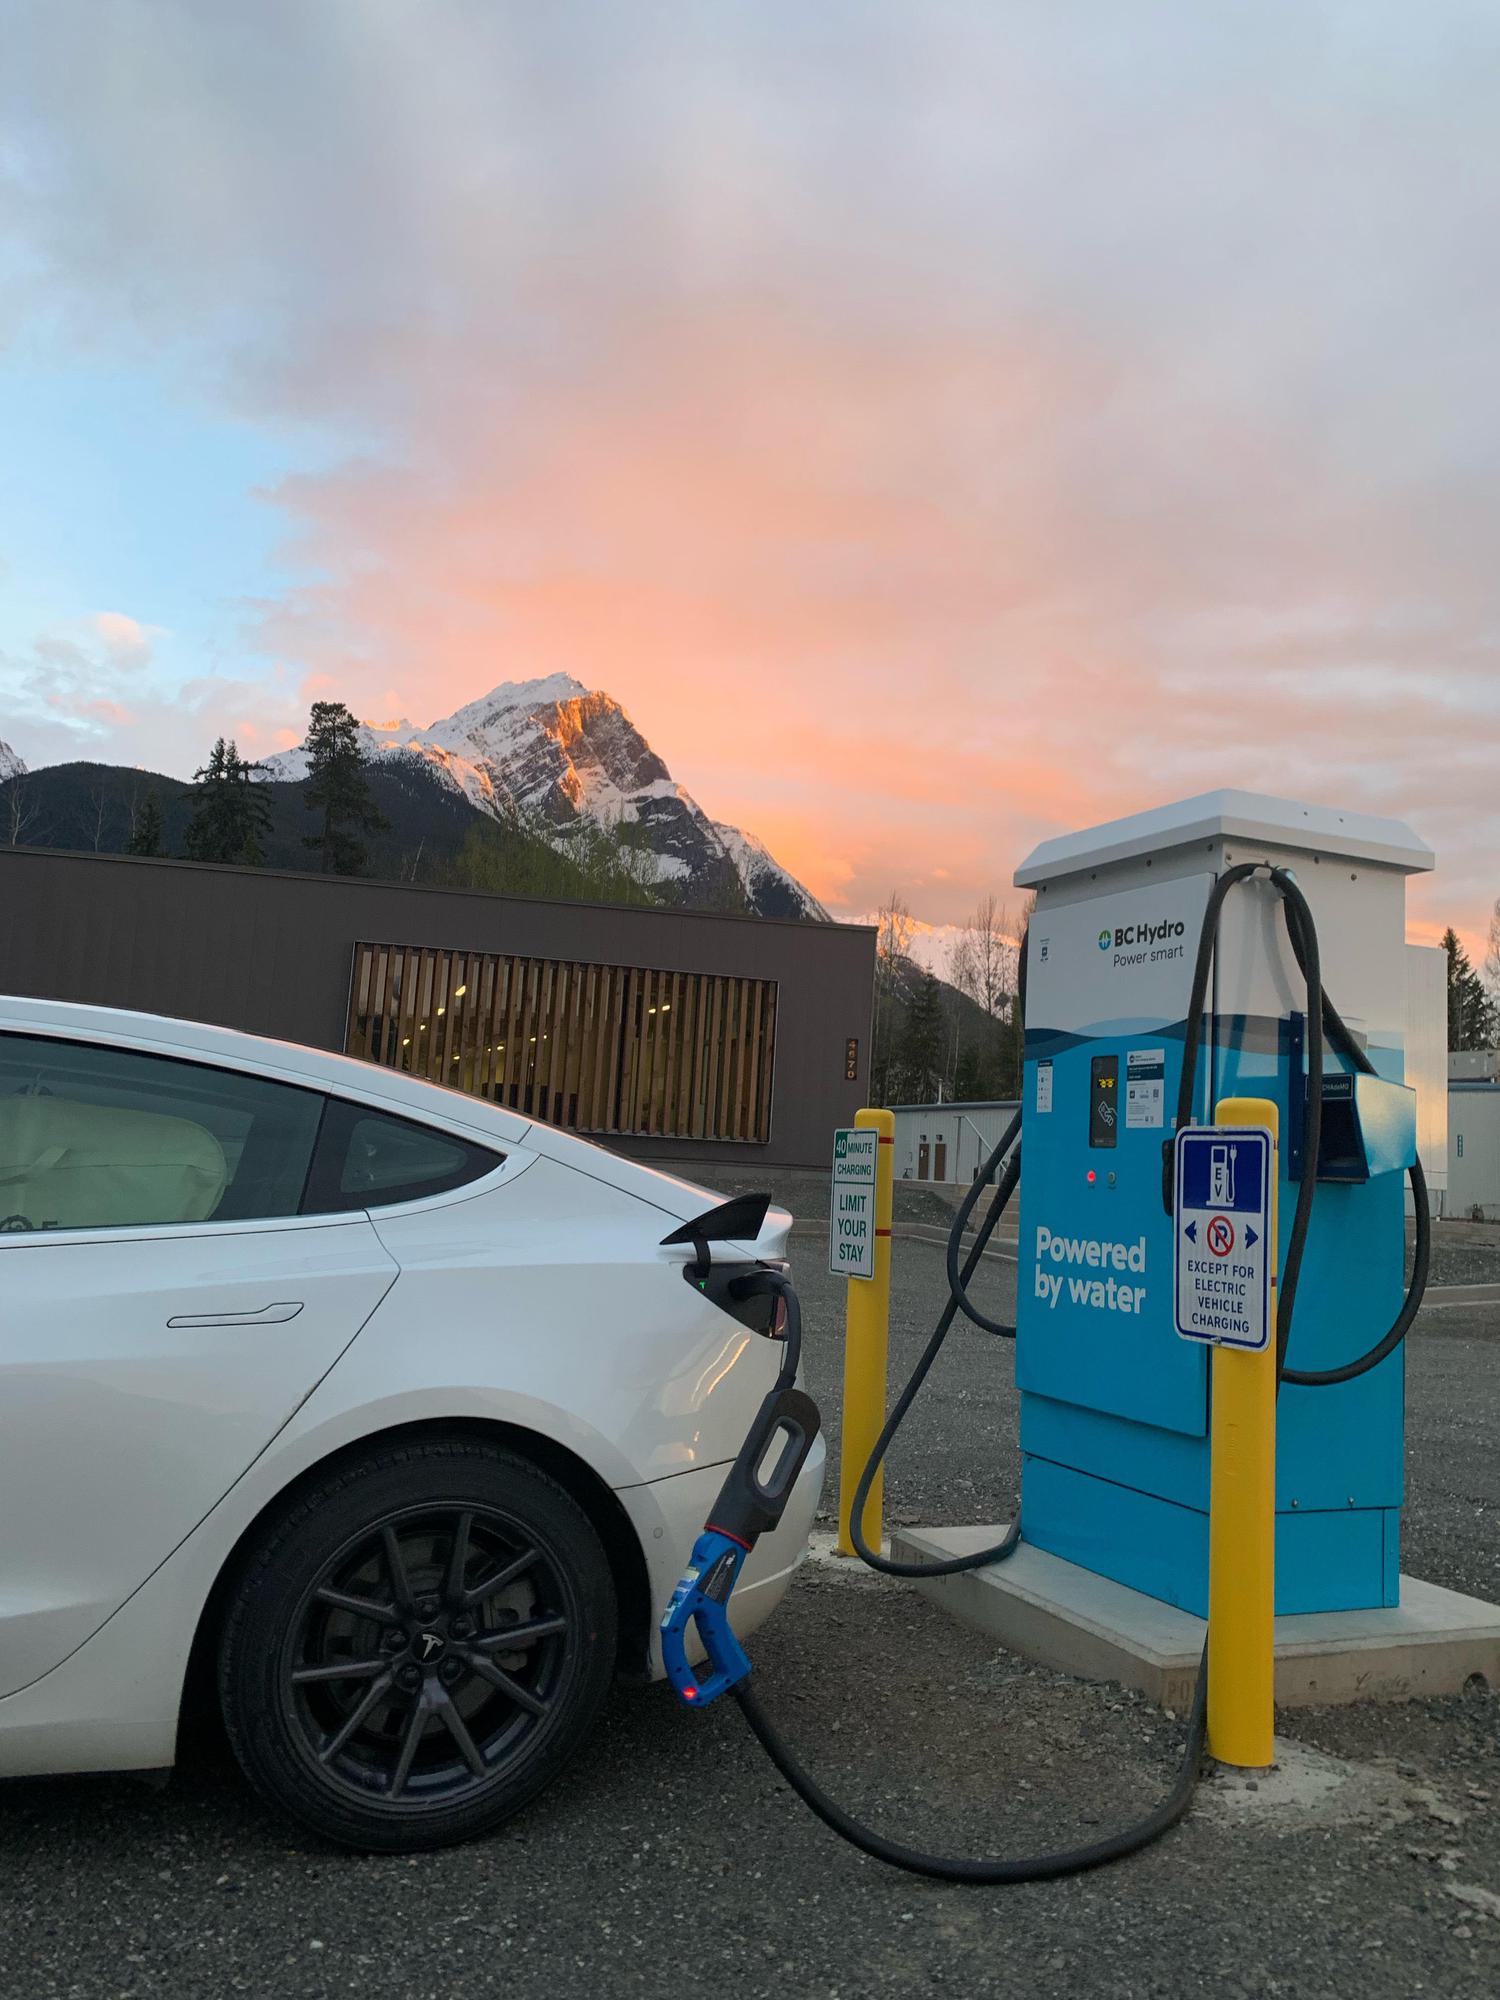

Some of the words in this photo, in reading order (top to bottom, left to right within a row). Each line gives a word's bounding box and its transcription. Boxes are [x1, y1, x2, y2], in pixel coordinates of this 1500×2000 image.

[1114, 926, 1134, 947] BC
[1136, 919, 1185, 945] Hydro
[1113, 952, 1147, 967] Power
[1150, 944, 1184, 962] smart
[836, 1139, 846, 1154] 40
[848, 1142, 873, 1154] MINUTE
[837, 1164, 872, 1176] CHARGING
[839, 1194, 867, 1212] LIMIT
[837, 1218, 867, 1238] YOUR
[839, 1242, 864, 1262] STAY
[1036, 1226, 1146, 1273] Powered
[1187, 1259, 1229, 1278] EXCEPT
[1232, 1264, 1255, 1280] FOR
[1034, 1263, 1064, 1309] by
[1067, 1277, 1146, 1314] water
[1194, 1280, 1246, 1297] ELECTRIC
[1198, 1296, 1243, 1314] VEHICLE
[1191, 1312, 1250, 1334] CHARGING
